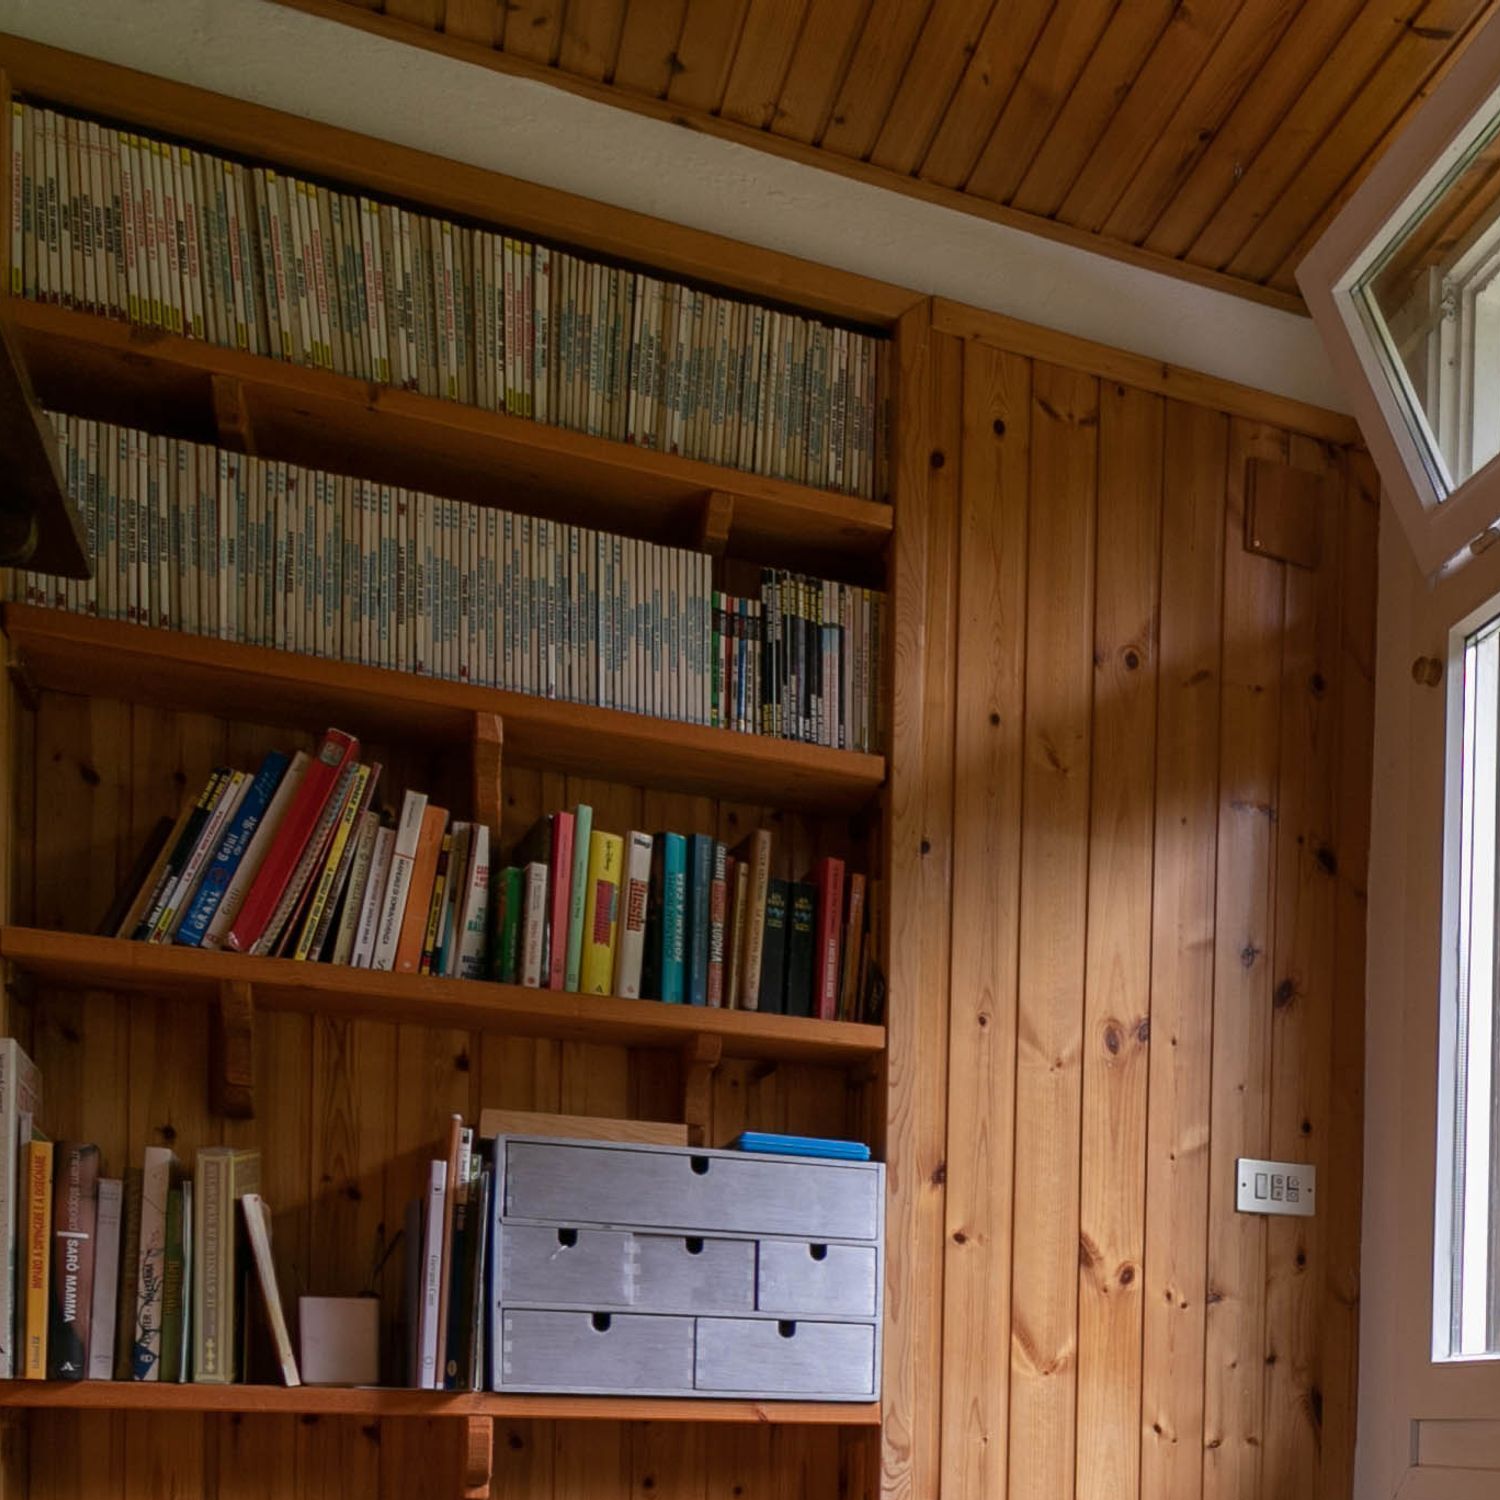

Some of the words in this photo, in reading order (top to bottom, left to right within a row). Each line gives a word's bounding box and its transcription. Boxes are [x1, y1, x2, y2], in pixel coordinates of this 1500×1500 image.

[198, 809, 224, 851] MISTERIOSA
[674, 872, 684, 899] CASA
[674, 903, 684, 911] A
[672, 914, 684, 961] PORTAMI
[33, 1155, 45, 1192] DISEGNARE
[69, 1150, 81, 1184] miriam
[66, 1186, 82, 1231] stoppard
[64, 1238, 81, 1272] SARÒ
[31, 1259, 42, 1288] IMPARO
[62, 1275, 77, 1323] MAMMA
